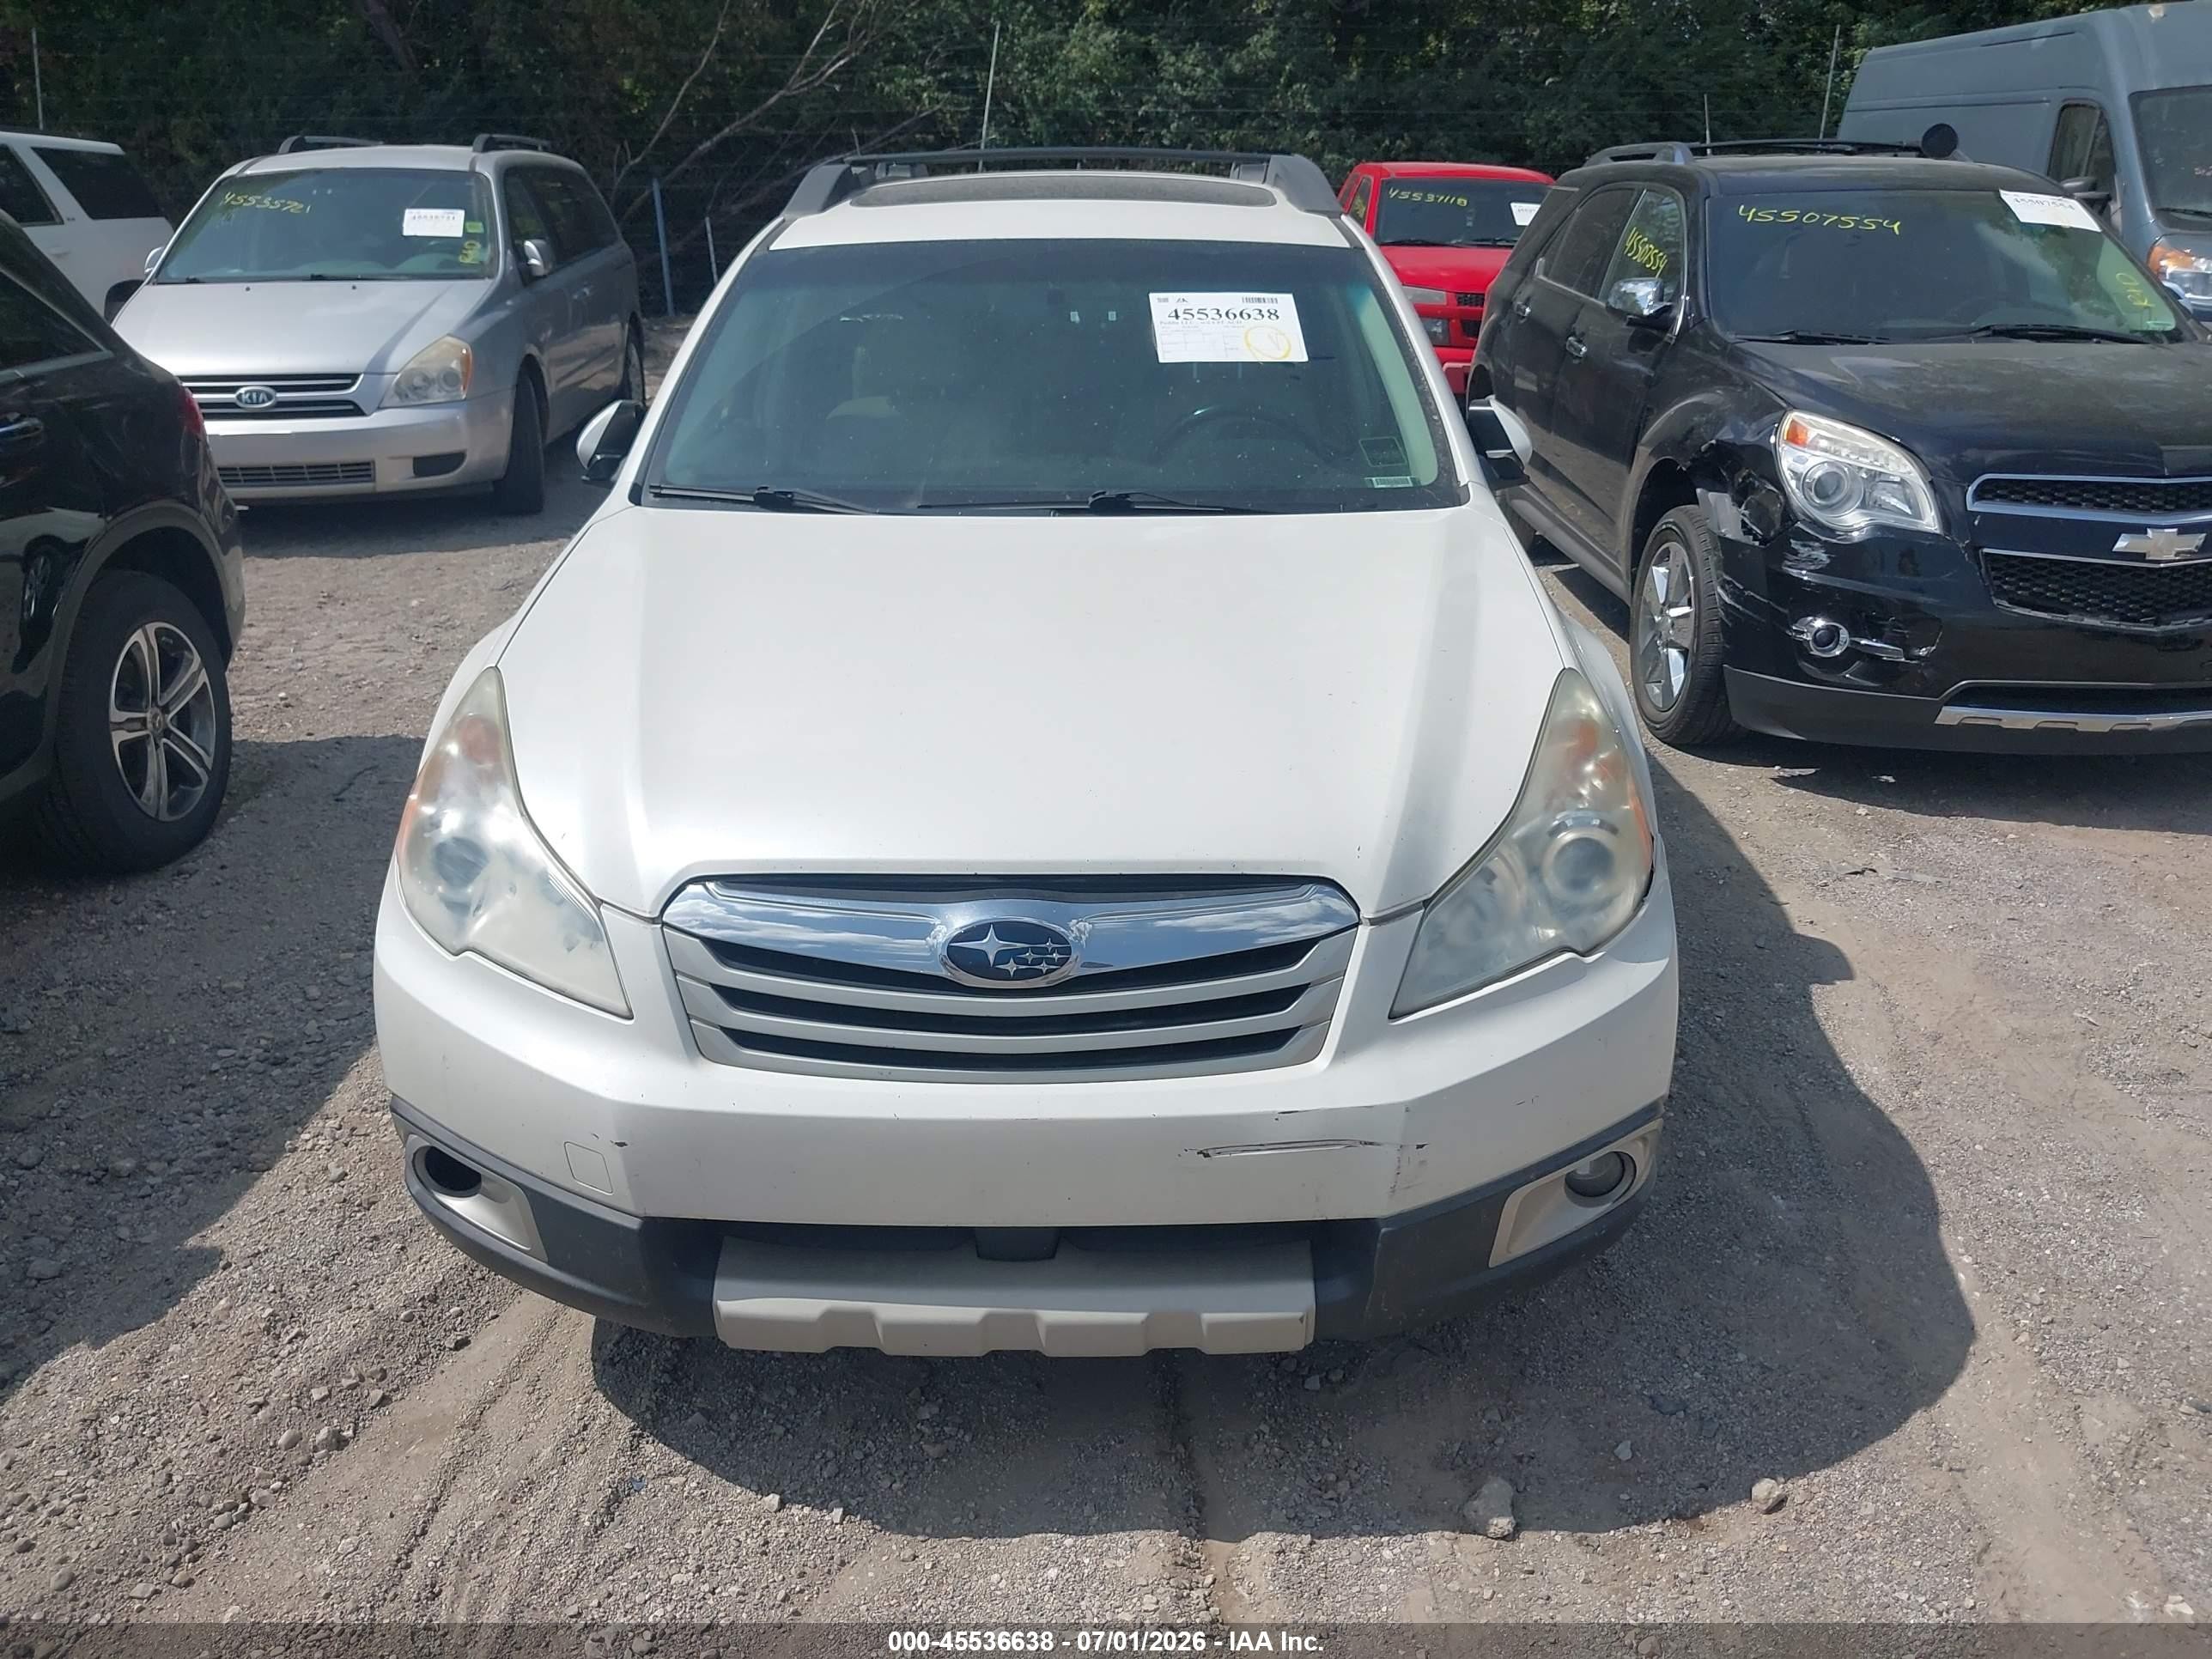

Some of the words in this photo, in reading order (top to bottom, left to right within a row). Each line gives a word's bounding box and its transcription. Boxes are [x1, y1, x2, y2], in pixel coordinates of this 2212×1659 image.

[1738, 204, 1901, 235] 45507554
[1167, 307, 1280, 321] 45536638
[240, 392, 269, 404] KIA
